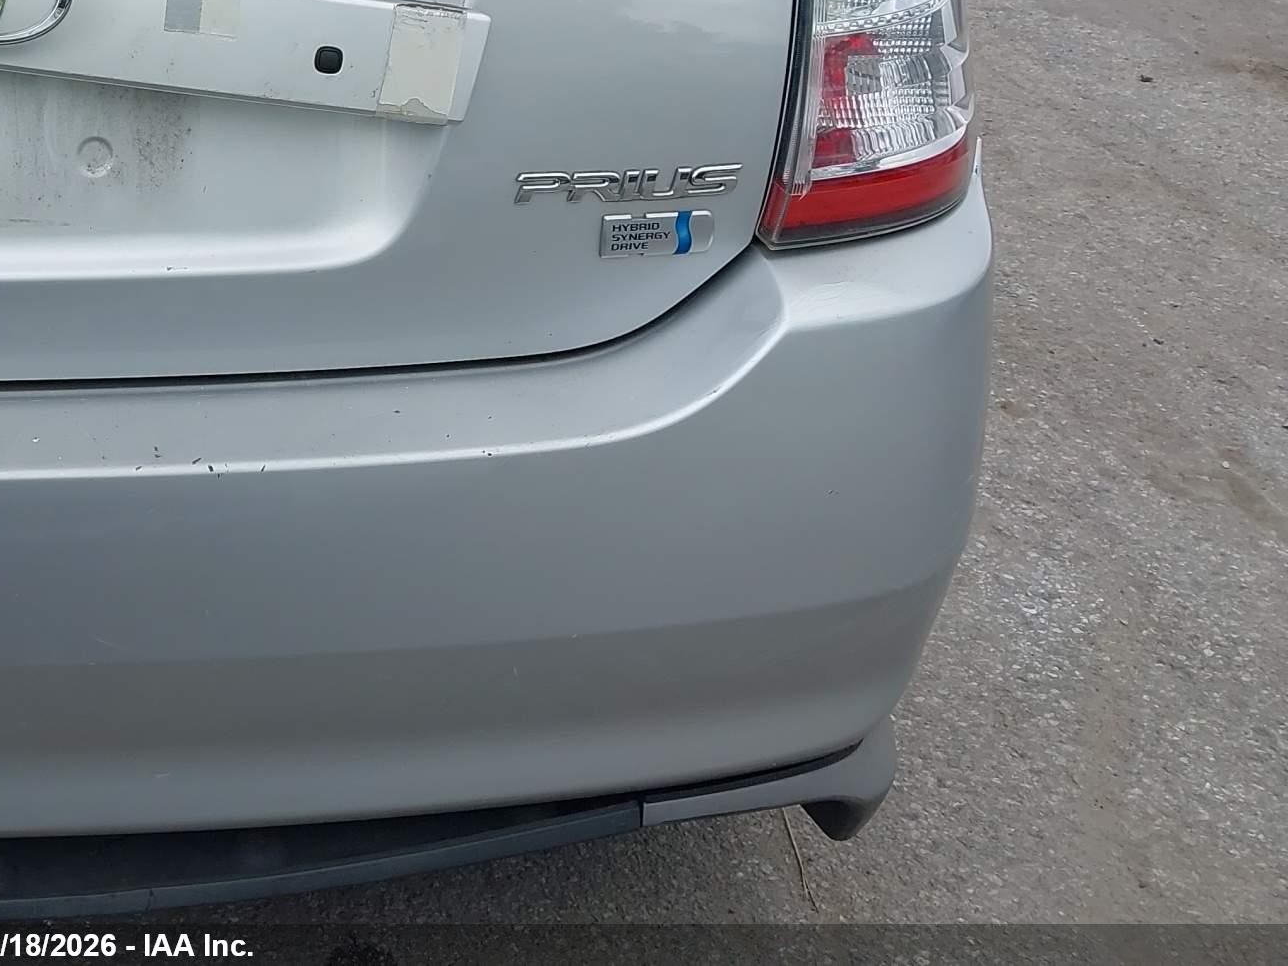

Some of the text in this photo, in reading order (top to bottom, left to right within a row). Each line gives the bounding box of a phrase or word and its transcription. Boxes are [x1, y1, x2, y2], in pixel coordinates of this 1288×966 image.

[514, 162, 744, 204] PRIUS
[612, 222, 660, 232] HYBRID
[611, 231, 671, 242] SYNERGY
[610, 241, 650, 252] DRIVE
